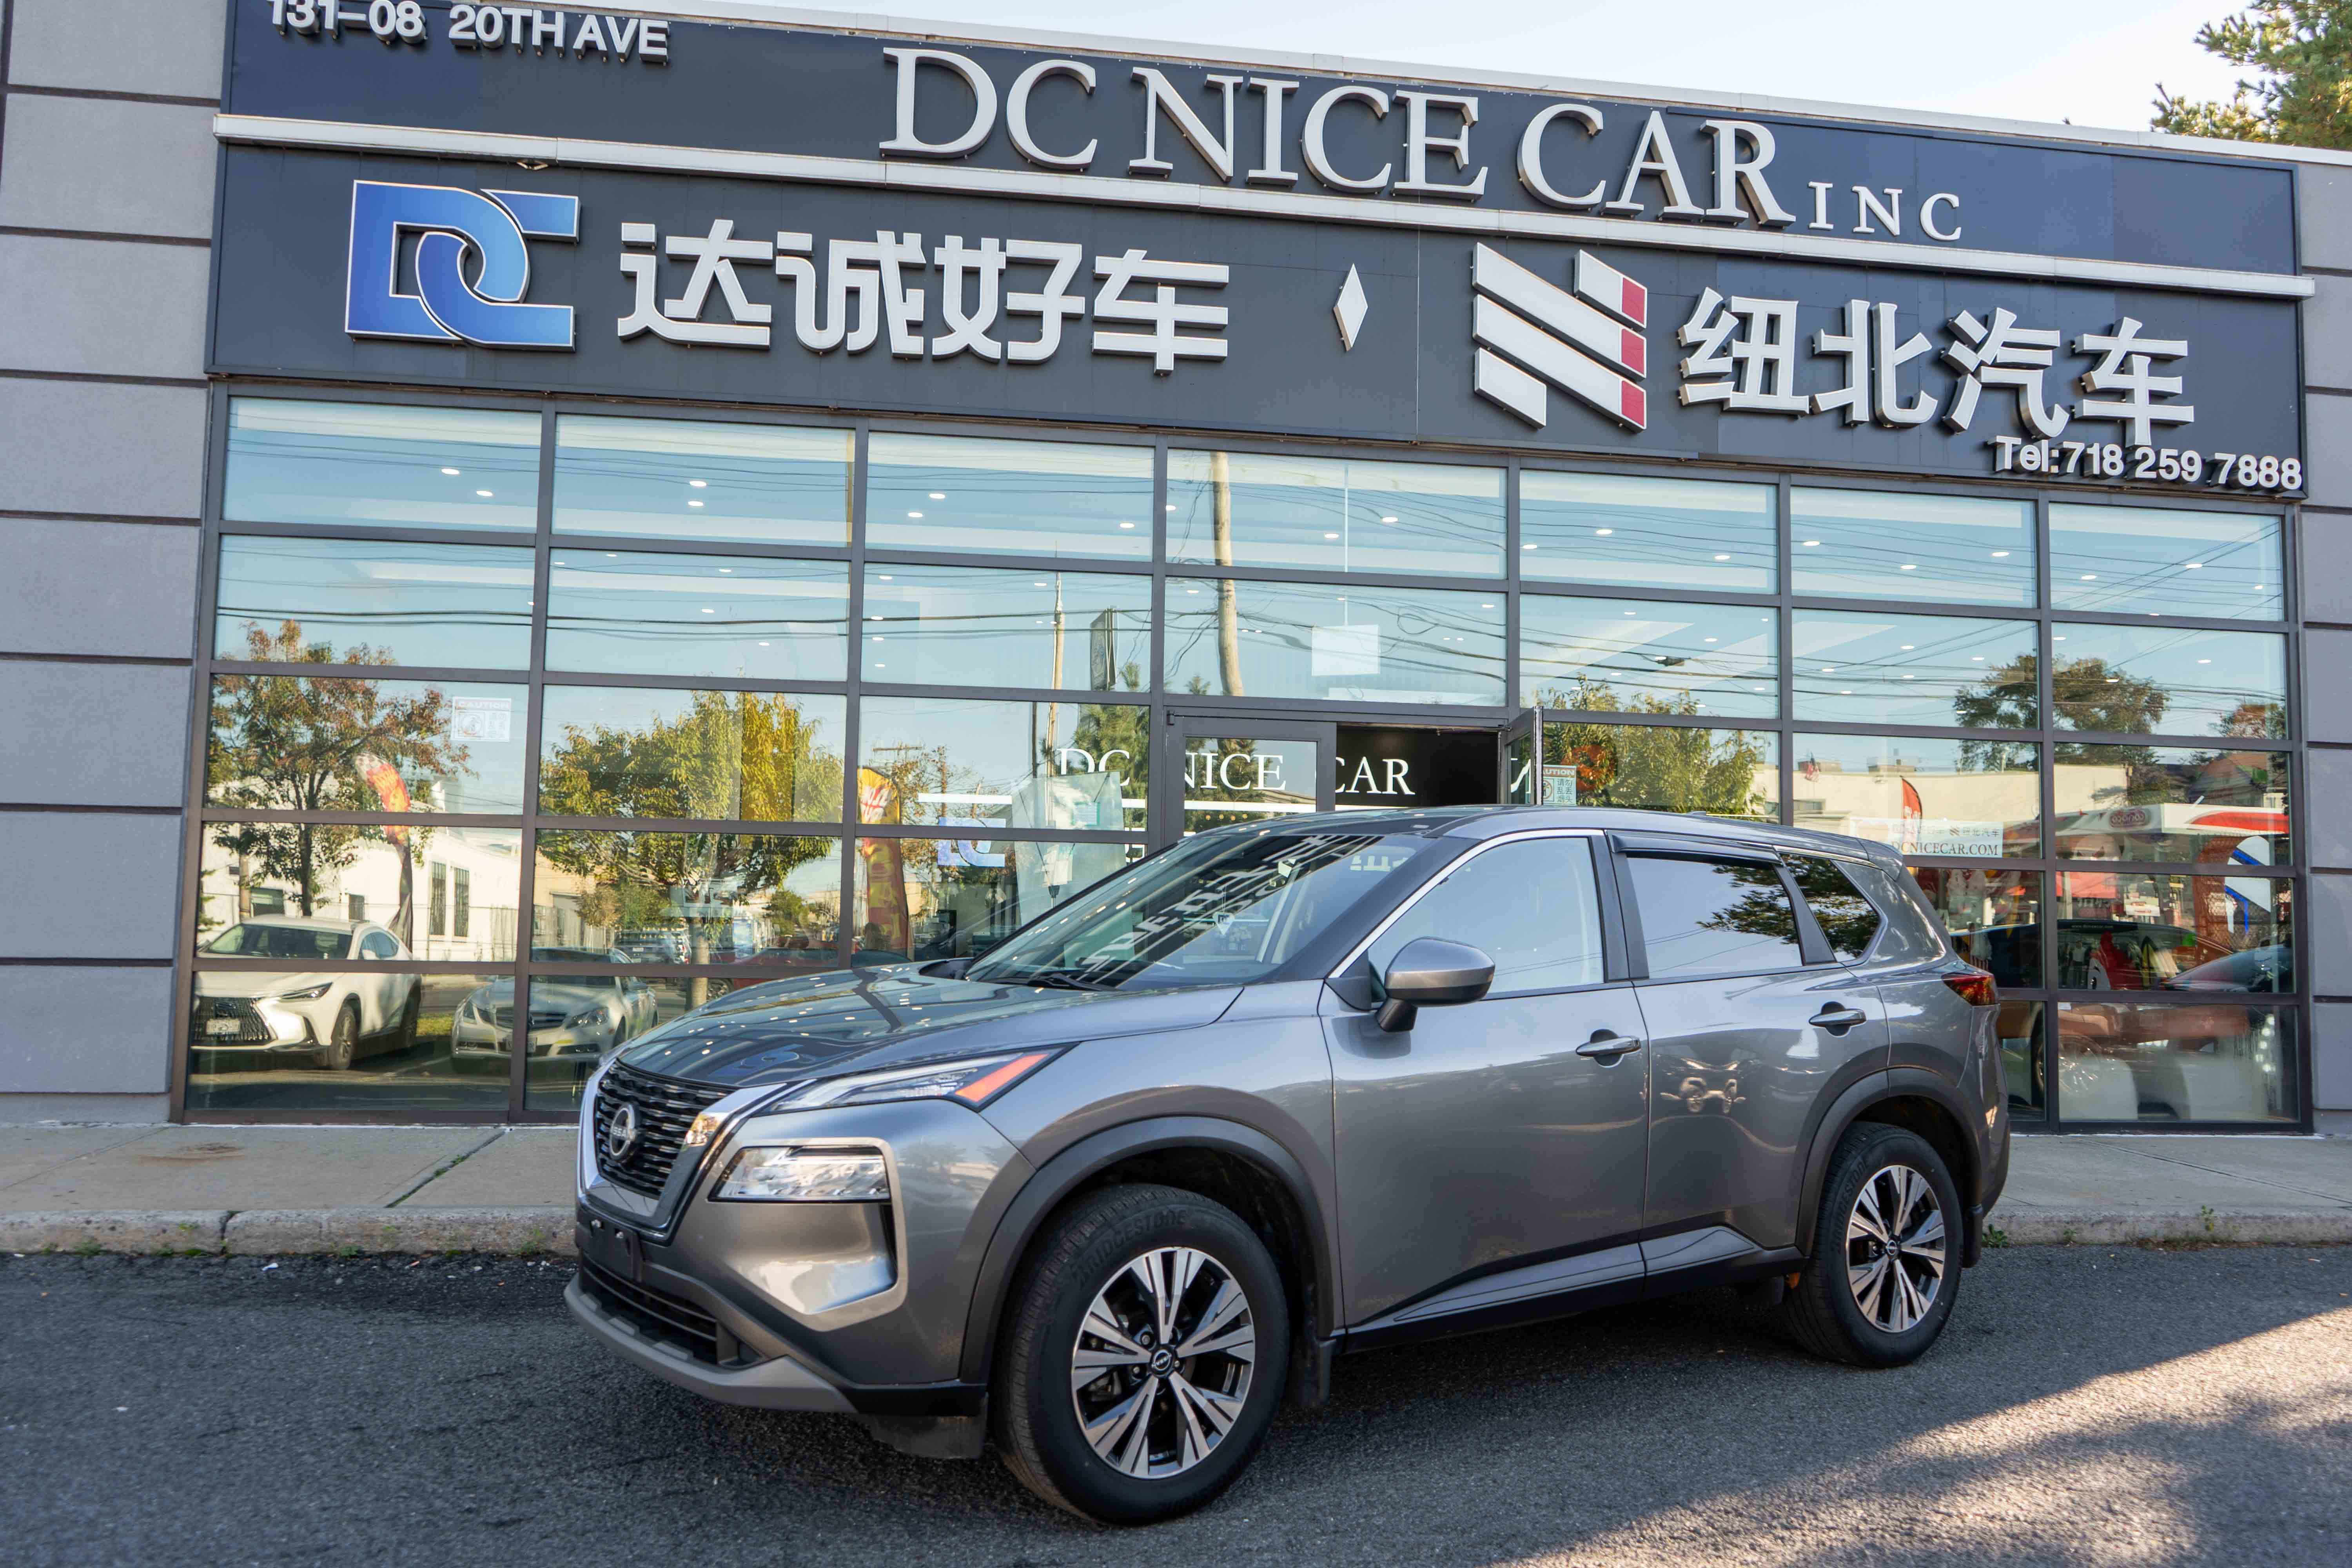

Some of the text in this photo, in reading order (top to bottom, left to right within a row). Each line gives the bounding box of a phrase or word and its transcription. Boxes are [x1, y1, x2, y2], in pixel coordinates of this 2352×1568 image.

[448, 4, 568, 49] 20TH
[573, 15, 670, 60] AVE
[879, 47, 1962, 241] DC NICE CAR INC
[618, 219, 1230, 375] 达诚好车
[1678, 287, 2194, 446] 纽北汽车
[2134, 447, 2202, 482] 259
[2211, 452, 2302, 489] 7888
